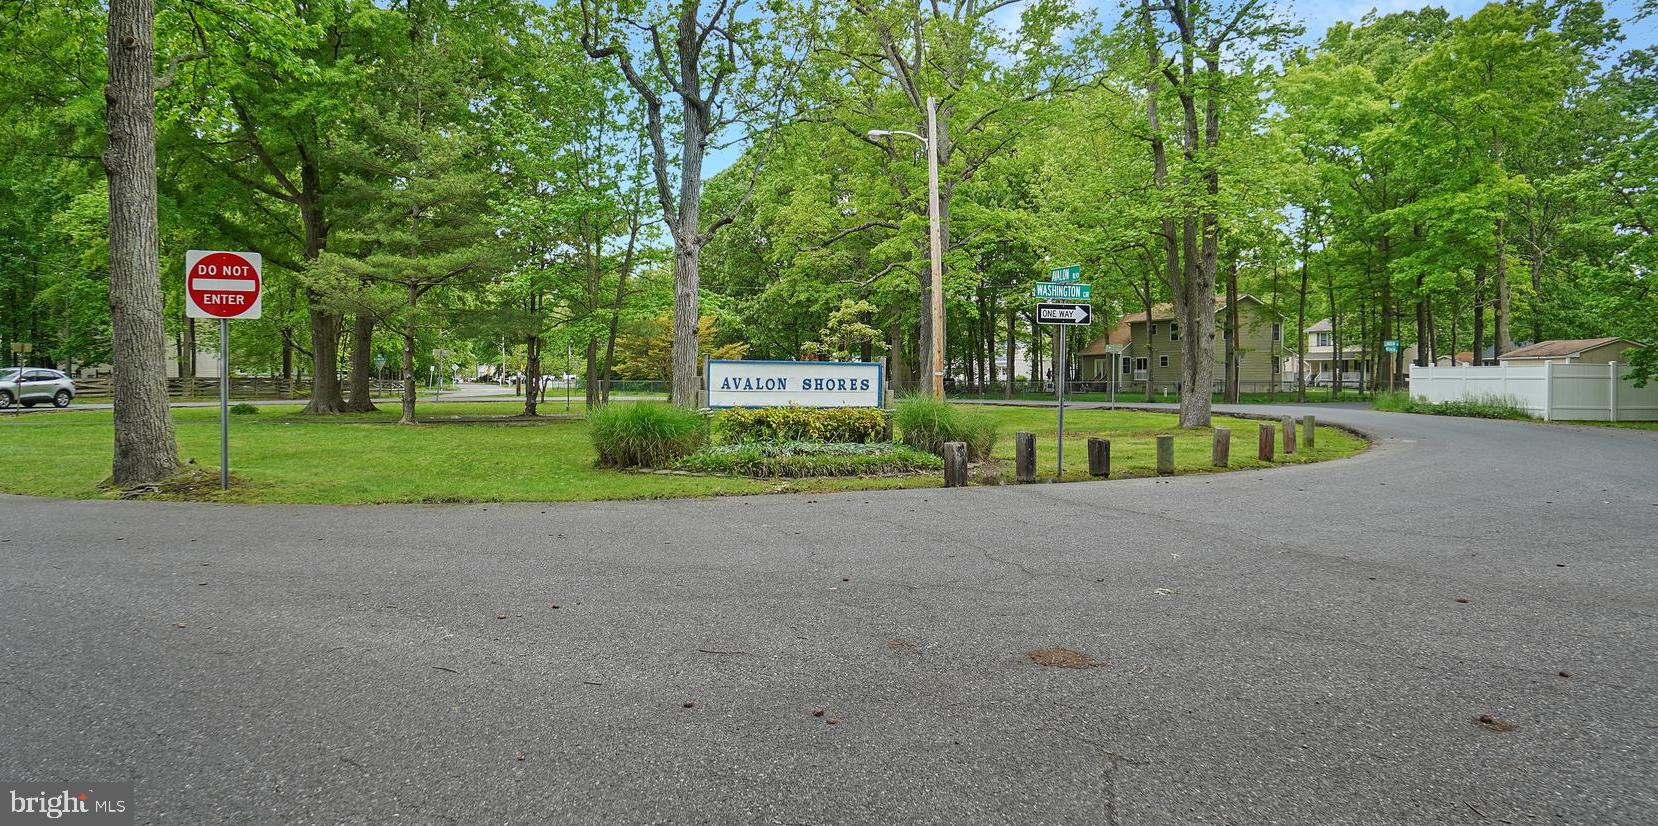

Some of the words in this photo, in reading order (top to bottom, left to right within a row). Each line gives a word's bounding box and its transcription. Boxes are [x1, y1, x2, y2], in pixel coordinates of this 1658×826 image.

[198, 264, 217, 276] DO
[222, 265, 249, 277] NOT
[1051, 268, 1070, 282] AVALON
[1036, 284, 1081, 298] WASHINGTON
[203, 293, 245, 305] ENTER
[1042, 309, 1057, 318] ONE
[1059, 309, 1074, 318] WAY
[721, 377, 787, 391] AVALON
[802, 378, 870, 391] SHORES
